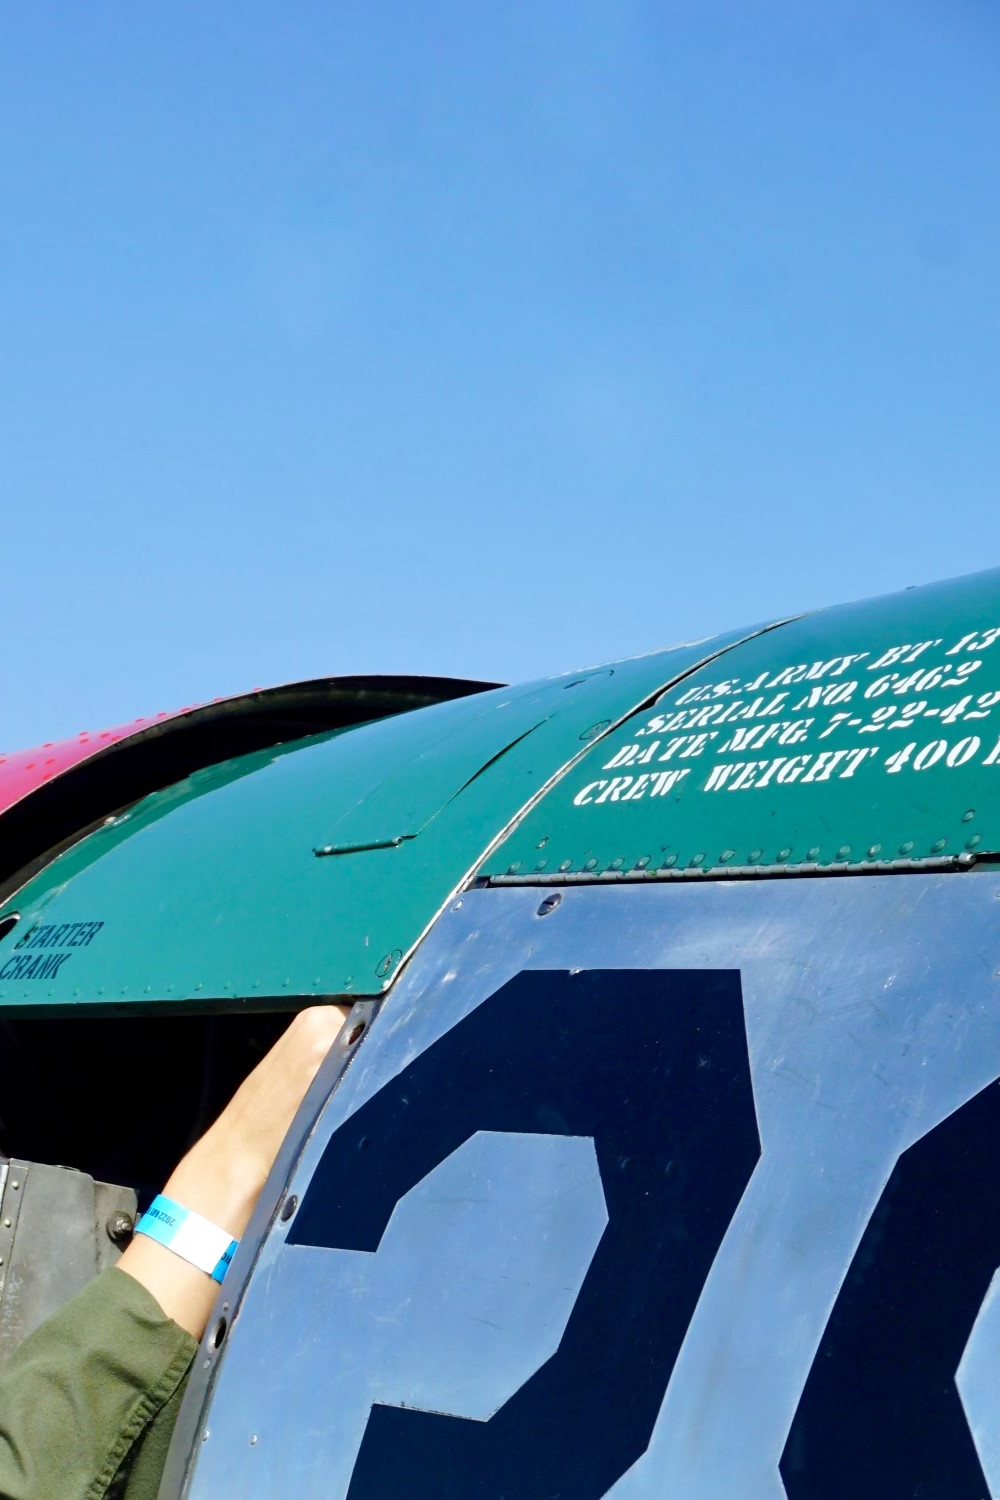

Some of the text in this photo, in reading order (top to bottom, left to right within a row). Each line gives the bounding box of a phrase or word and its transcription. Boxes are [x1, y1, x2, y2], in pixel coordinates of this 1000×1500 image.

[867, 638, 943, 670] BT
[945, 627, 1000, 655] 13
[602, 731, 719, 770] DATE
[818, 690, 1000, 740] 7-22-42
[634, 692, 790, 737] SERIAL
[864, 660, 982, 699] 6462
[573, 768, 691, 806] CREW
[703, 746, 879, 792] WEIGHT
[885, 735, 981, 774] 400
[14, 921, 105, 951] STARTER
